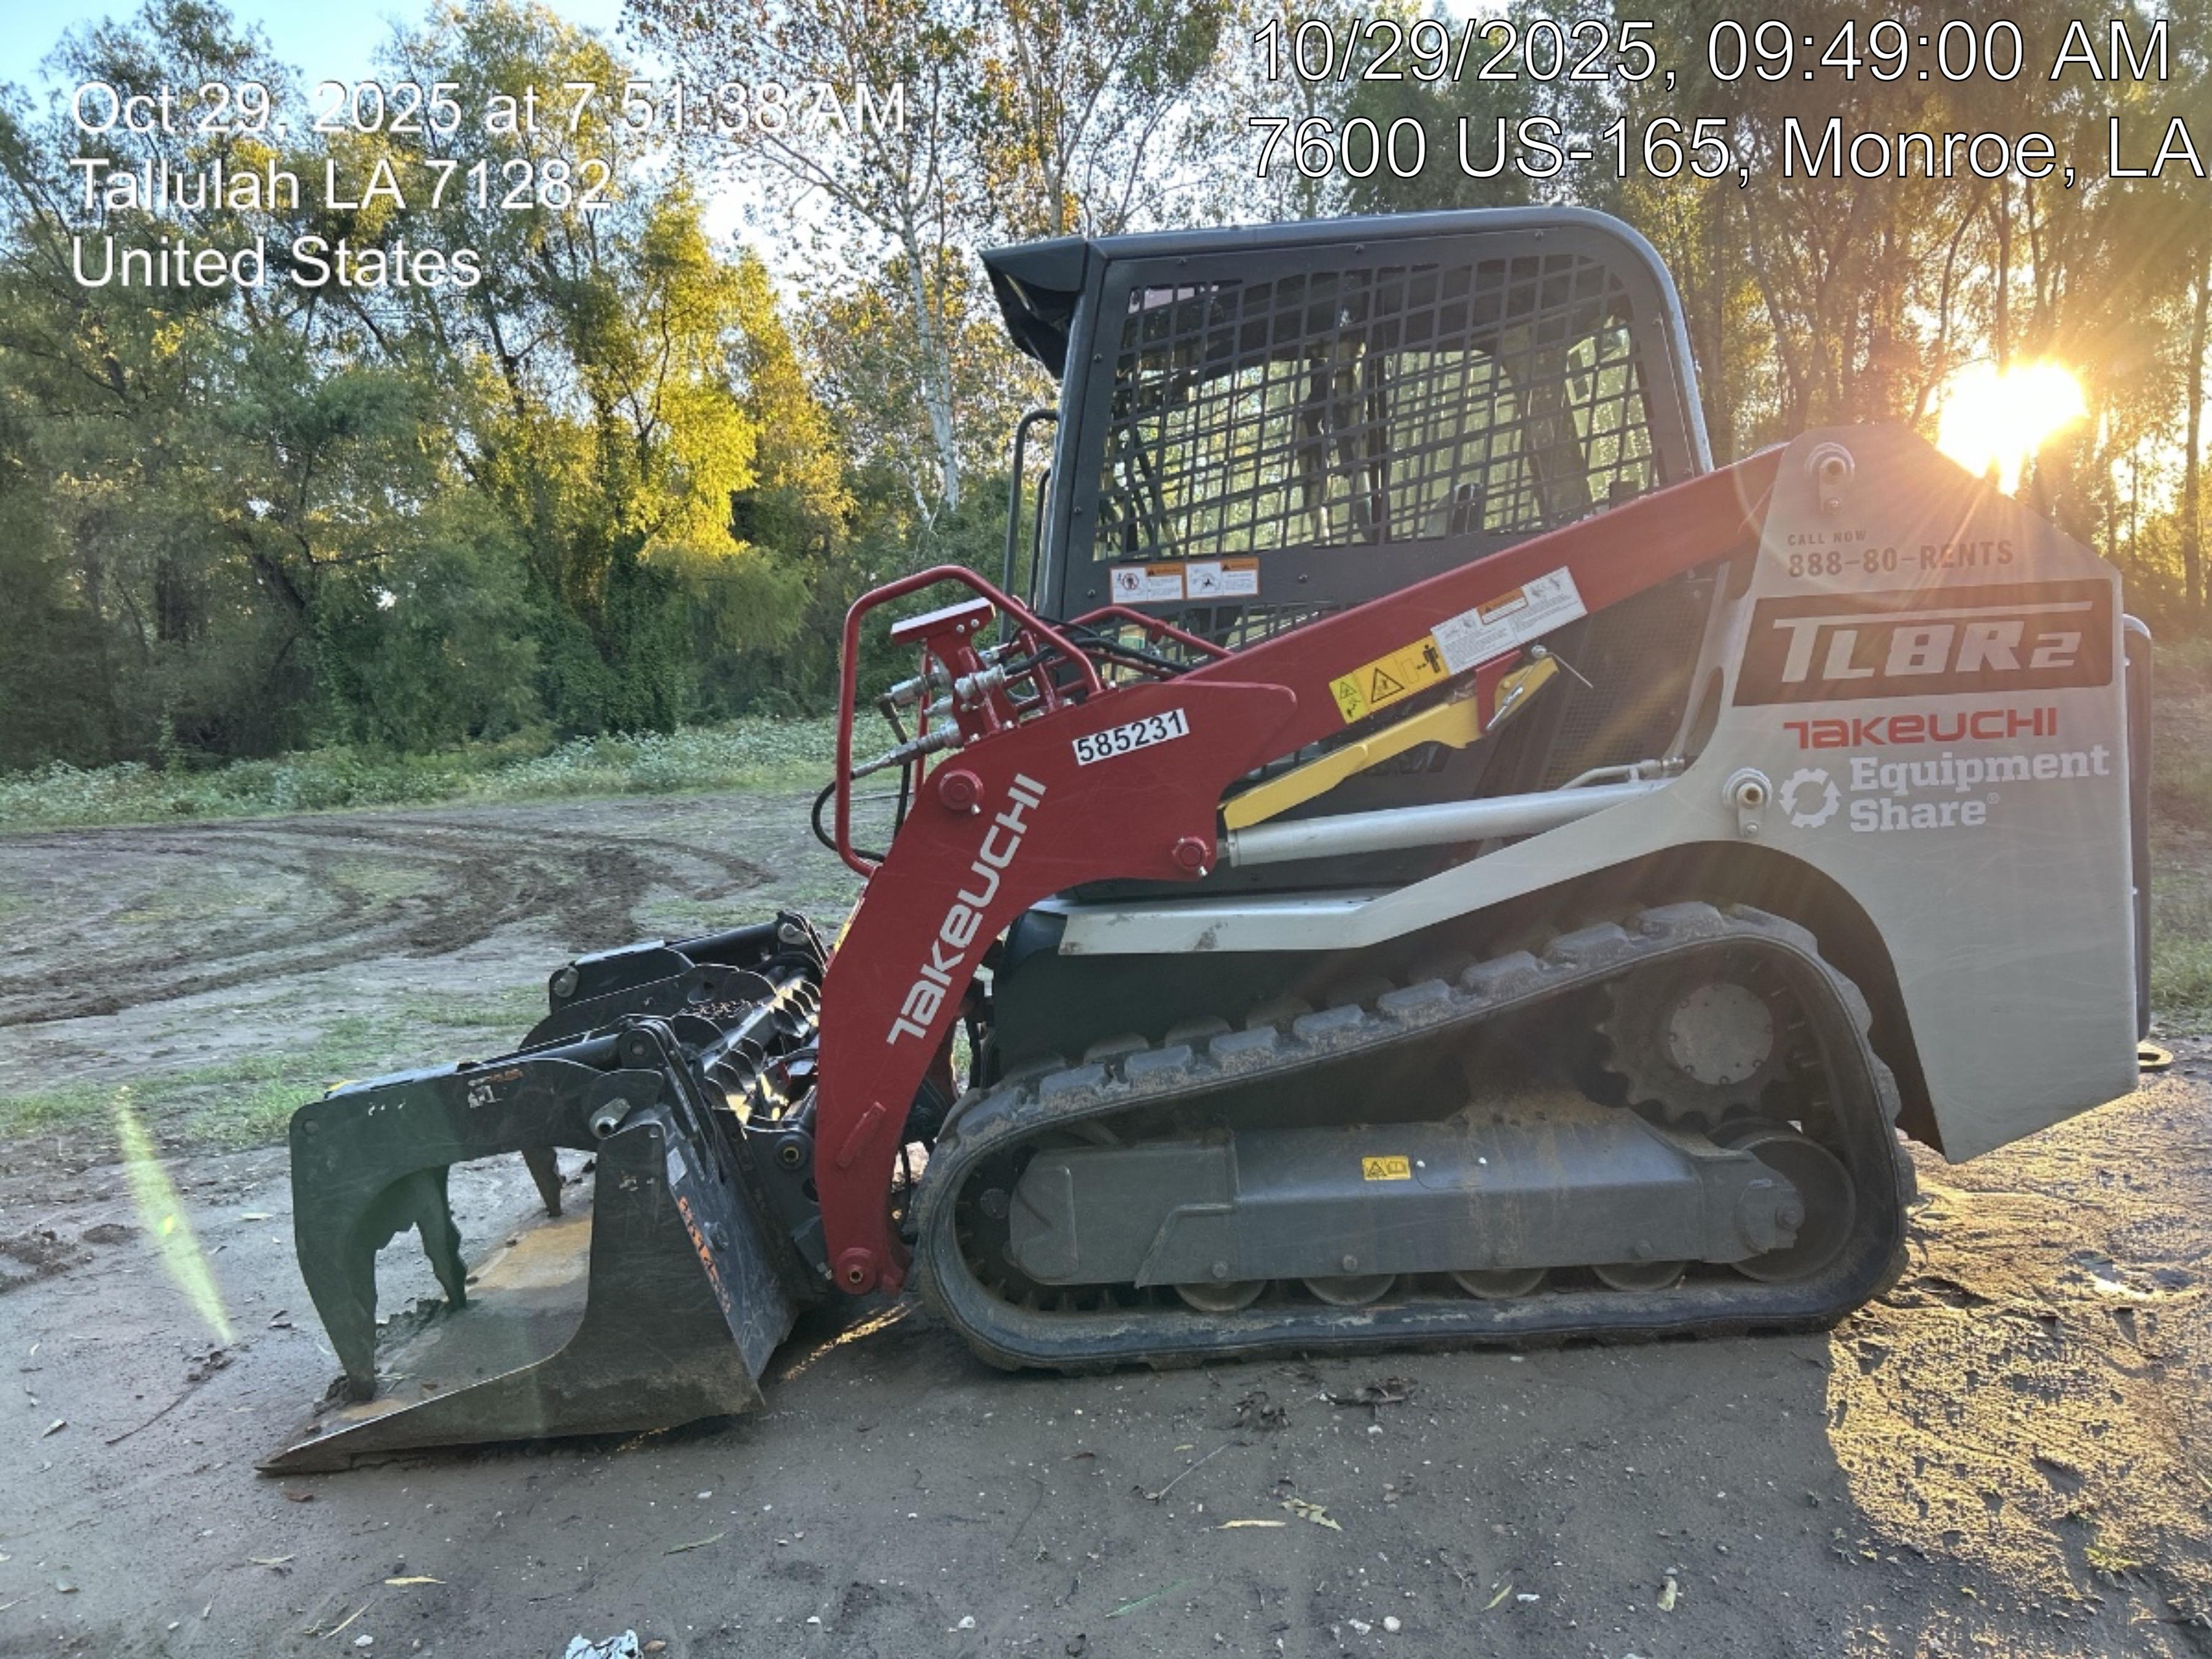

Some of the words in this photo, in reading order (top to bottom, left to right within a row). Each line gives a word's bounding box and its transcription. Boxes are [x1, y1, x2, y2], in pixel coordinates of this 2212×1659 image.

[1787, 533, 1826, 546] CALL
[1833, 530, 1867, 543] NOW
[1789, 539, 2014, 578] 888-80-RENTS
[1077, 710, 1188, 764] 585231
[1849, 743, 2110, 795] Equipment
